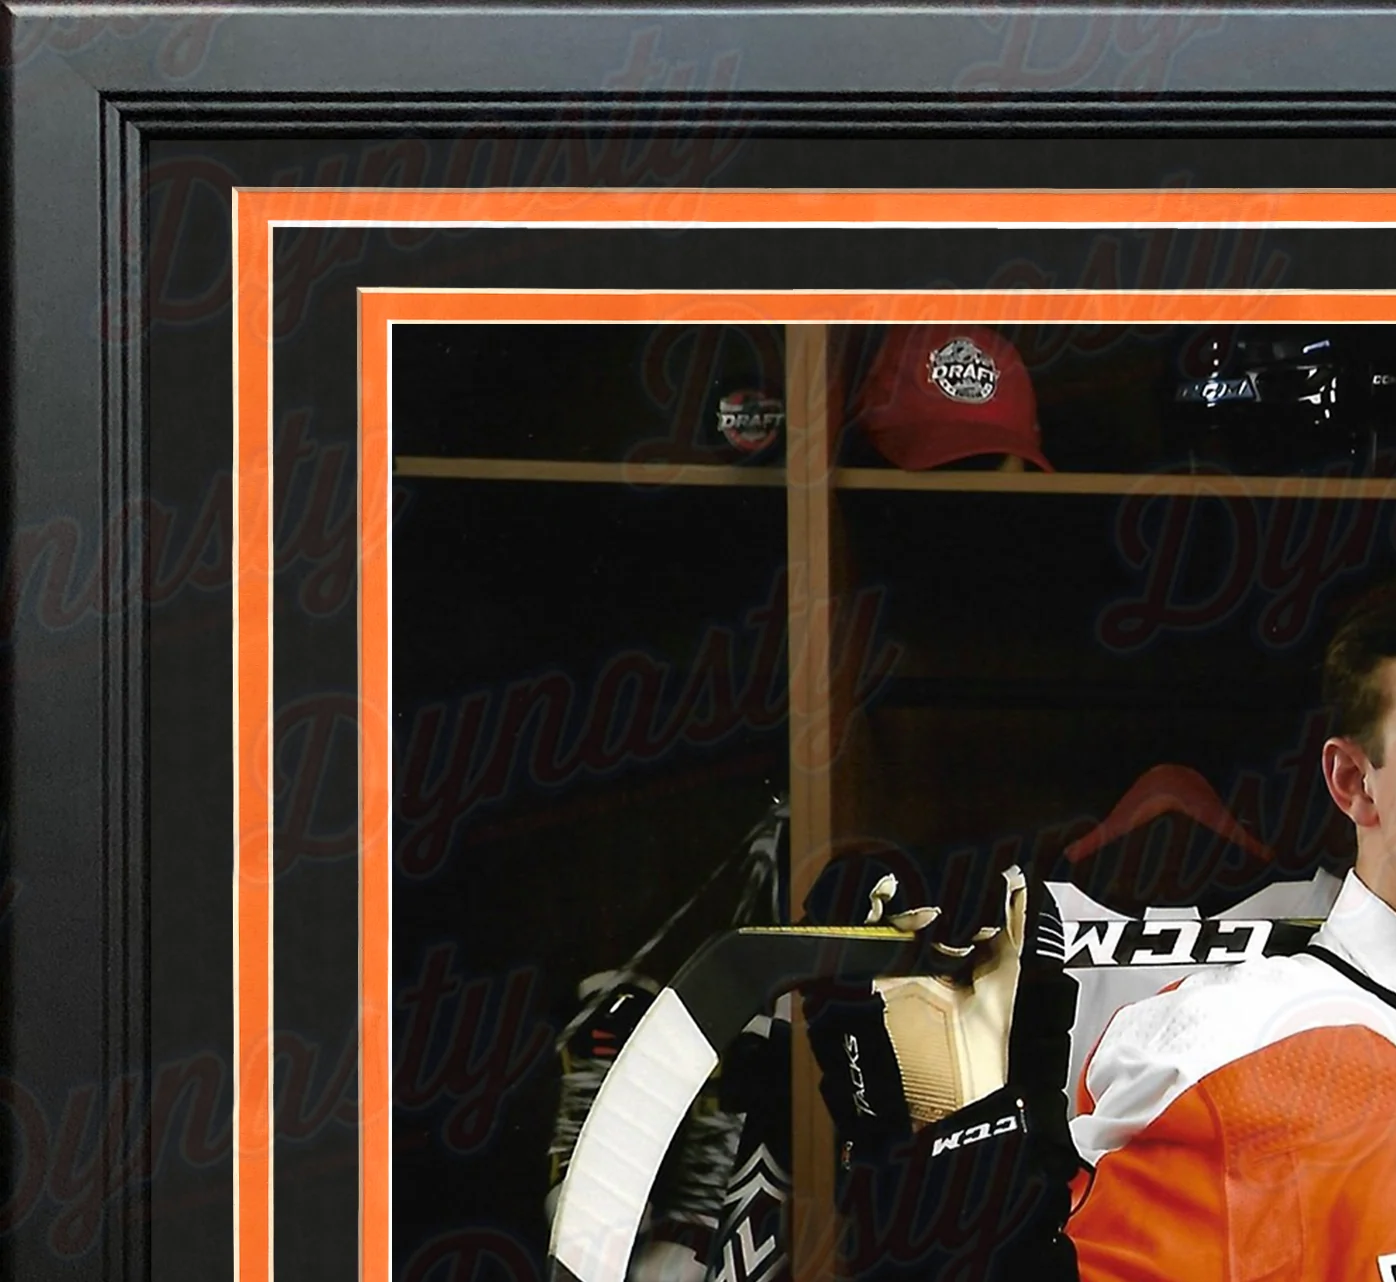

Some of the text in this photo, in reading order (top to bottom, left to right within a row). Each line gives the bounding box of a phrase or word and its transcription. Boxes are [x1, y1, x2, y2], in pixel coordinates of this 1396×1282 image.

[932, 364, 994, 382] DRAFT
[718, 412, 784, 431] DRAFT
[1063, 920, 1273, 965] CCM
[844, 1033, 876, 1117] TACKS
[931, 1115, 1018, 1157] CCM
